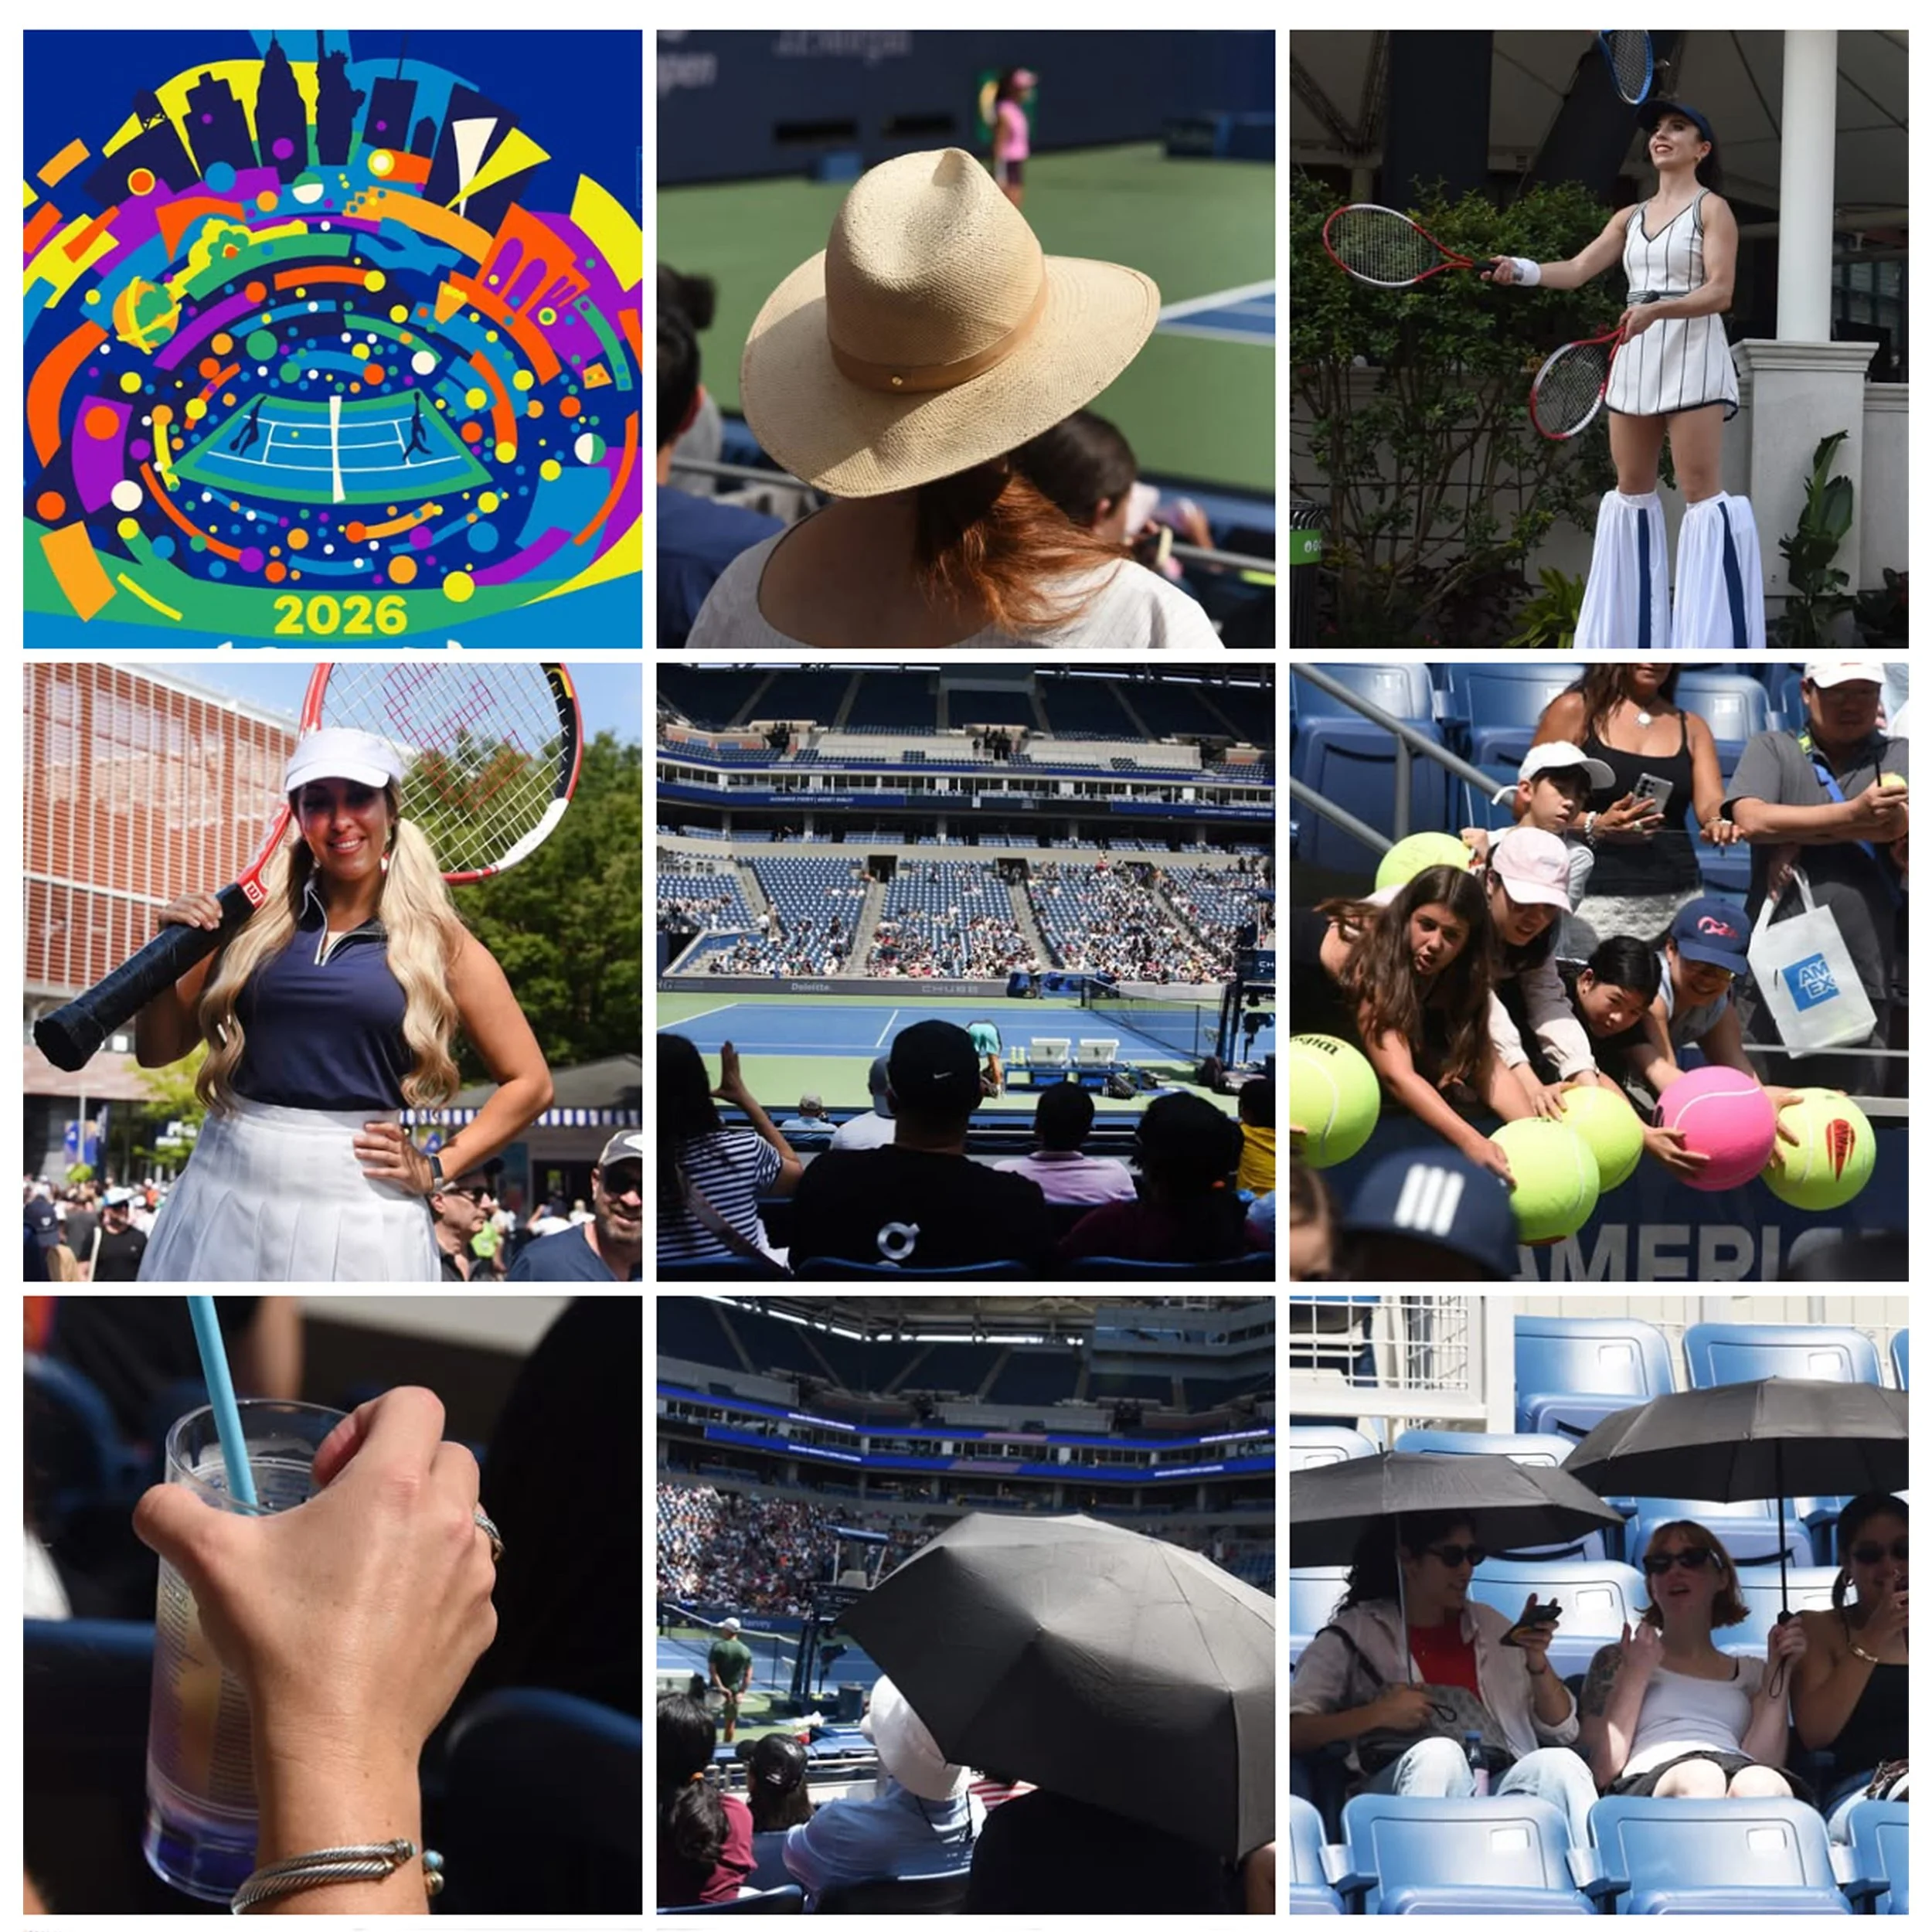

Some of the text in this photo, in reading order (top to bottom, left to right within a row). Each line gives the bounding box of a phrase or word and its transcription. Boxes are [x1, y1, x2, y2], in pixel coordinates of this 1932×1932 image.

[274, 594, 408, 635] 2026
[1799, 960, 1830, 988] AM
[1806, 974, 1837, 999] EX
[1511, 1224, 1886, 1281] MERI
